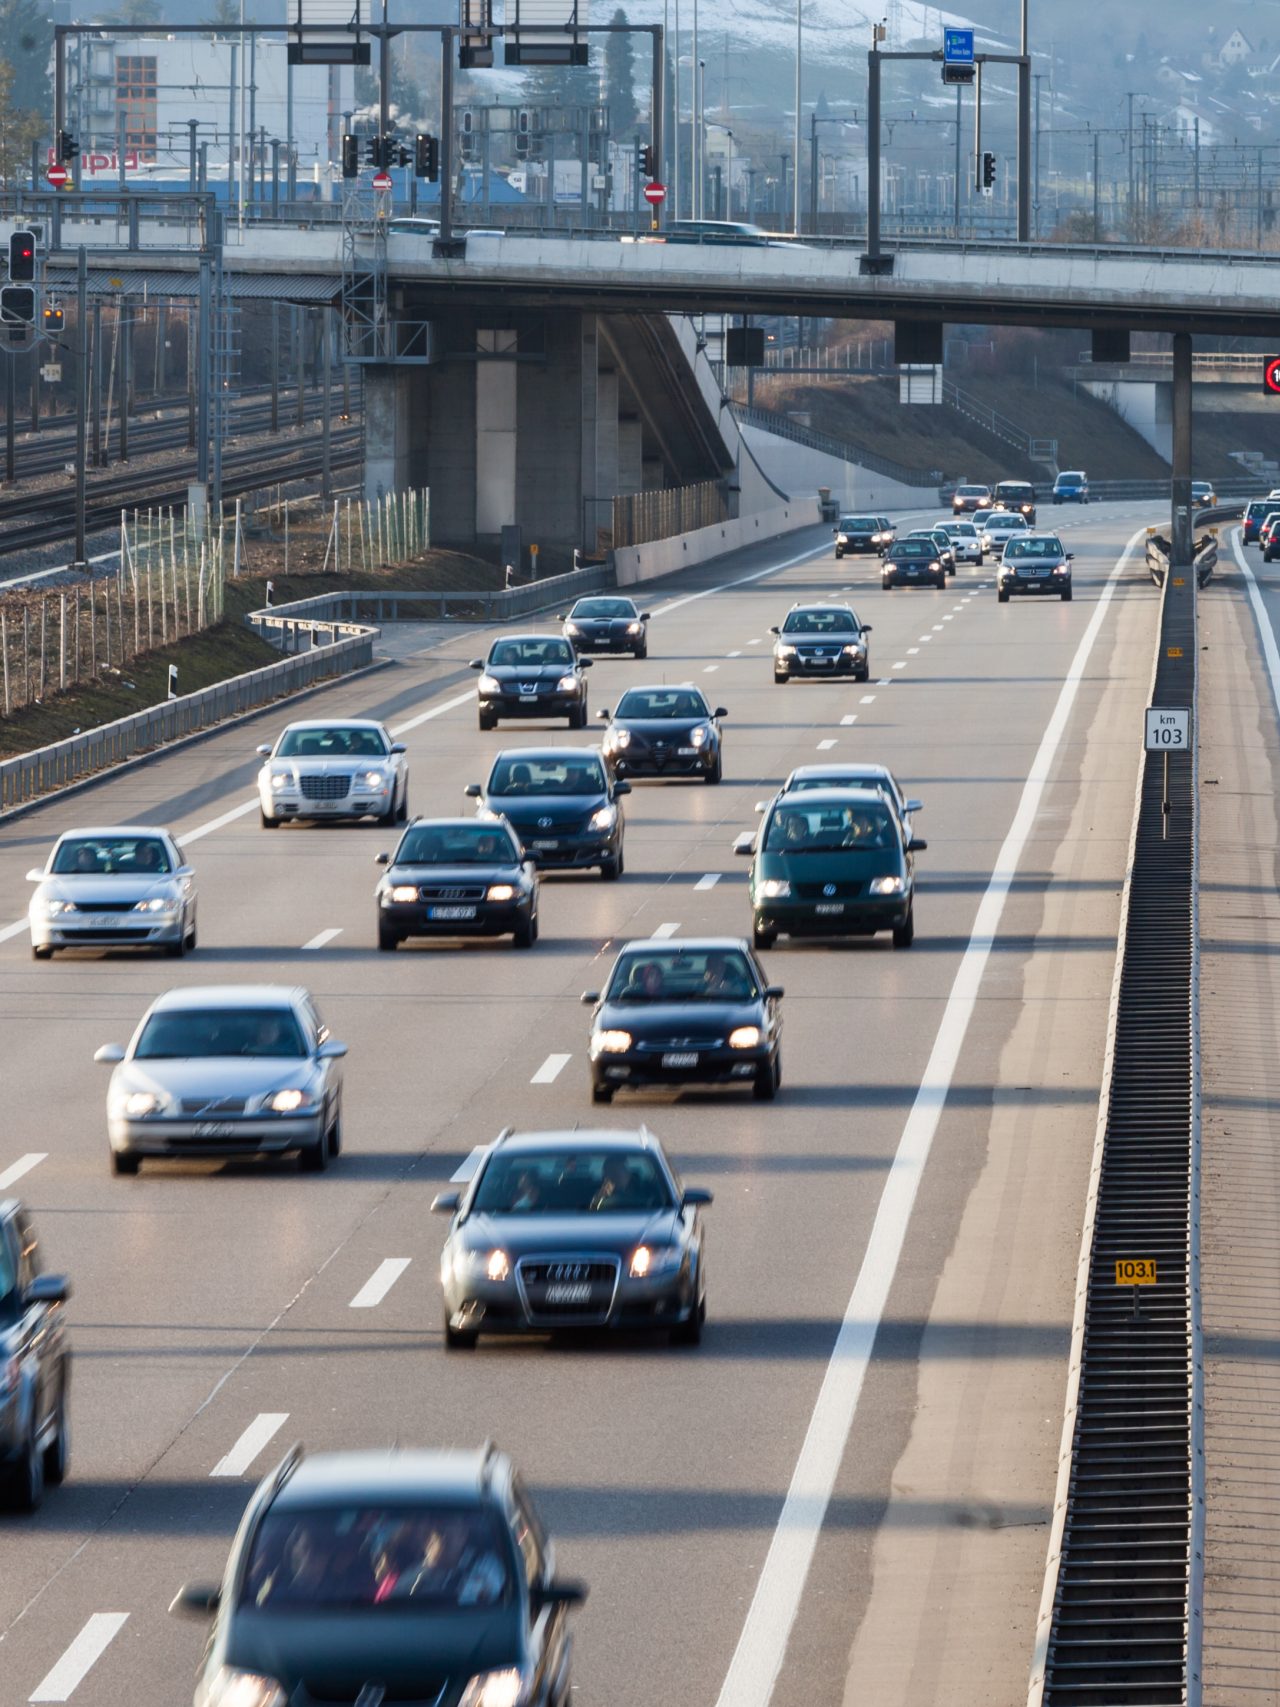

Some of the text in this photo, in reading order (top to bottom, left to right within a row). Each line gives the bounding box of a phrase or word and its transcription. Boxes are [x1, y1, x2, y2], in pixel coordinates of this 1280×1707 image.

[1160, 715, 1176, 725] km
[1153, 729, 1182, 744] 103
[1118, 1262, 1154, 1278] 103.1
